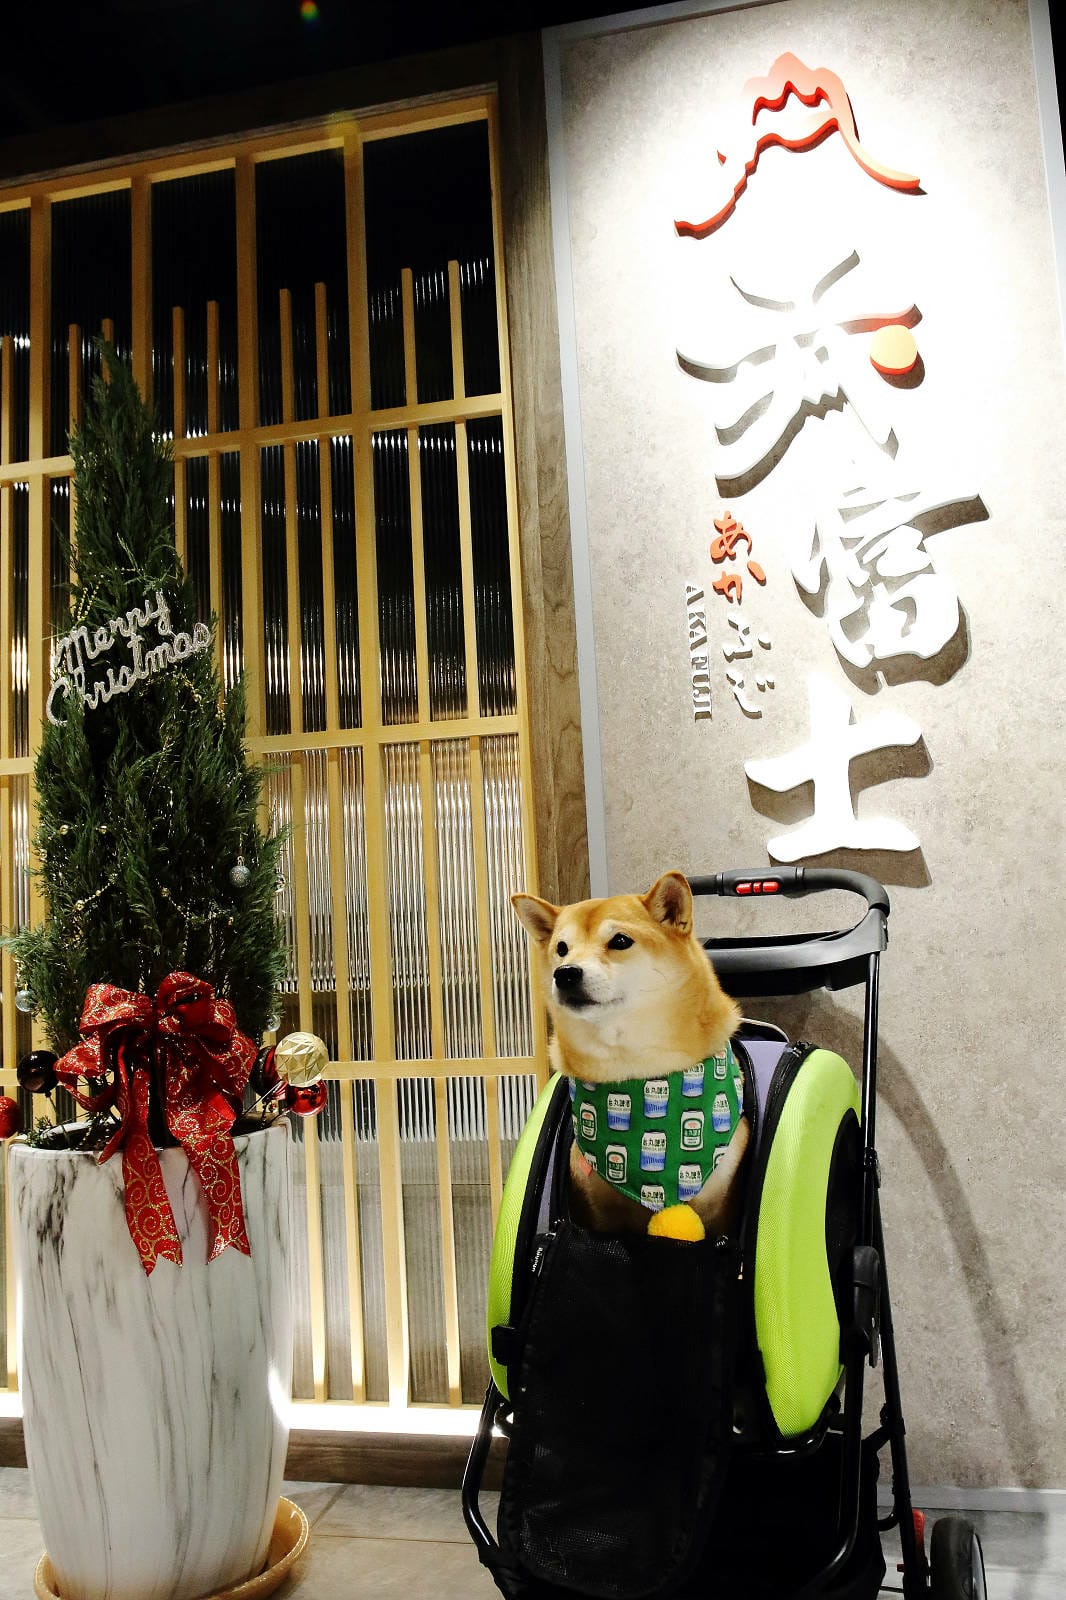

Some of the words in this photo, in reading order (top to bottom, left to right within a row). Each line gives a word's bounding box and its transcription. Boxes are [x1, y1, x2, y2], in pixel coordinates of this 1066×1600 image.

[46, 622, 211, 727] Christmas
[54, 590, 171, 674] Merry
[685, 582, 713, 722] AKAFUJI
